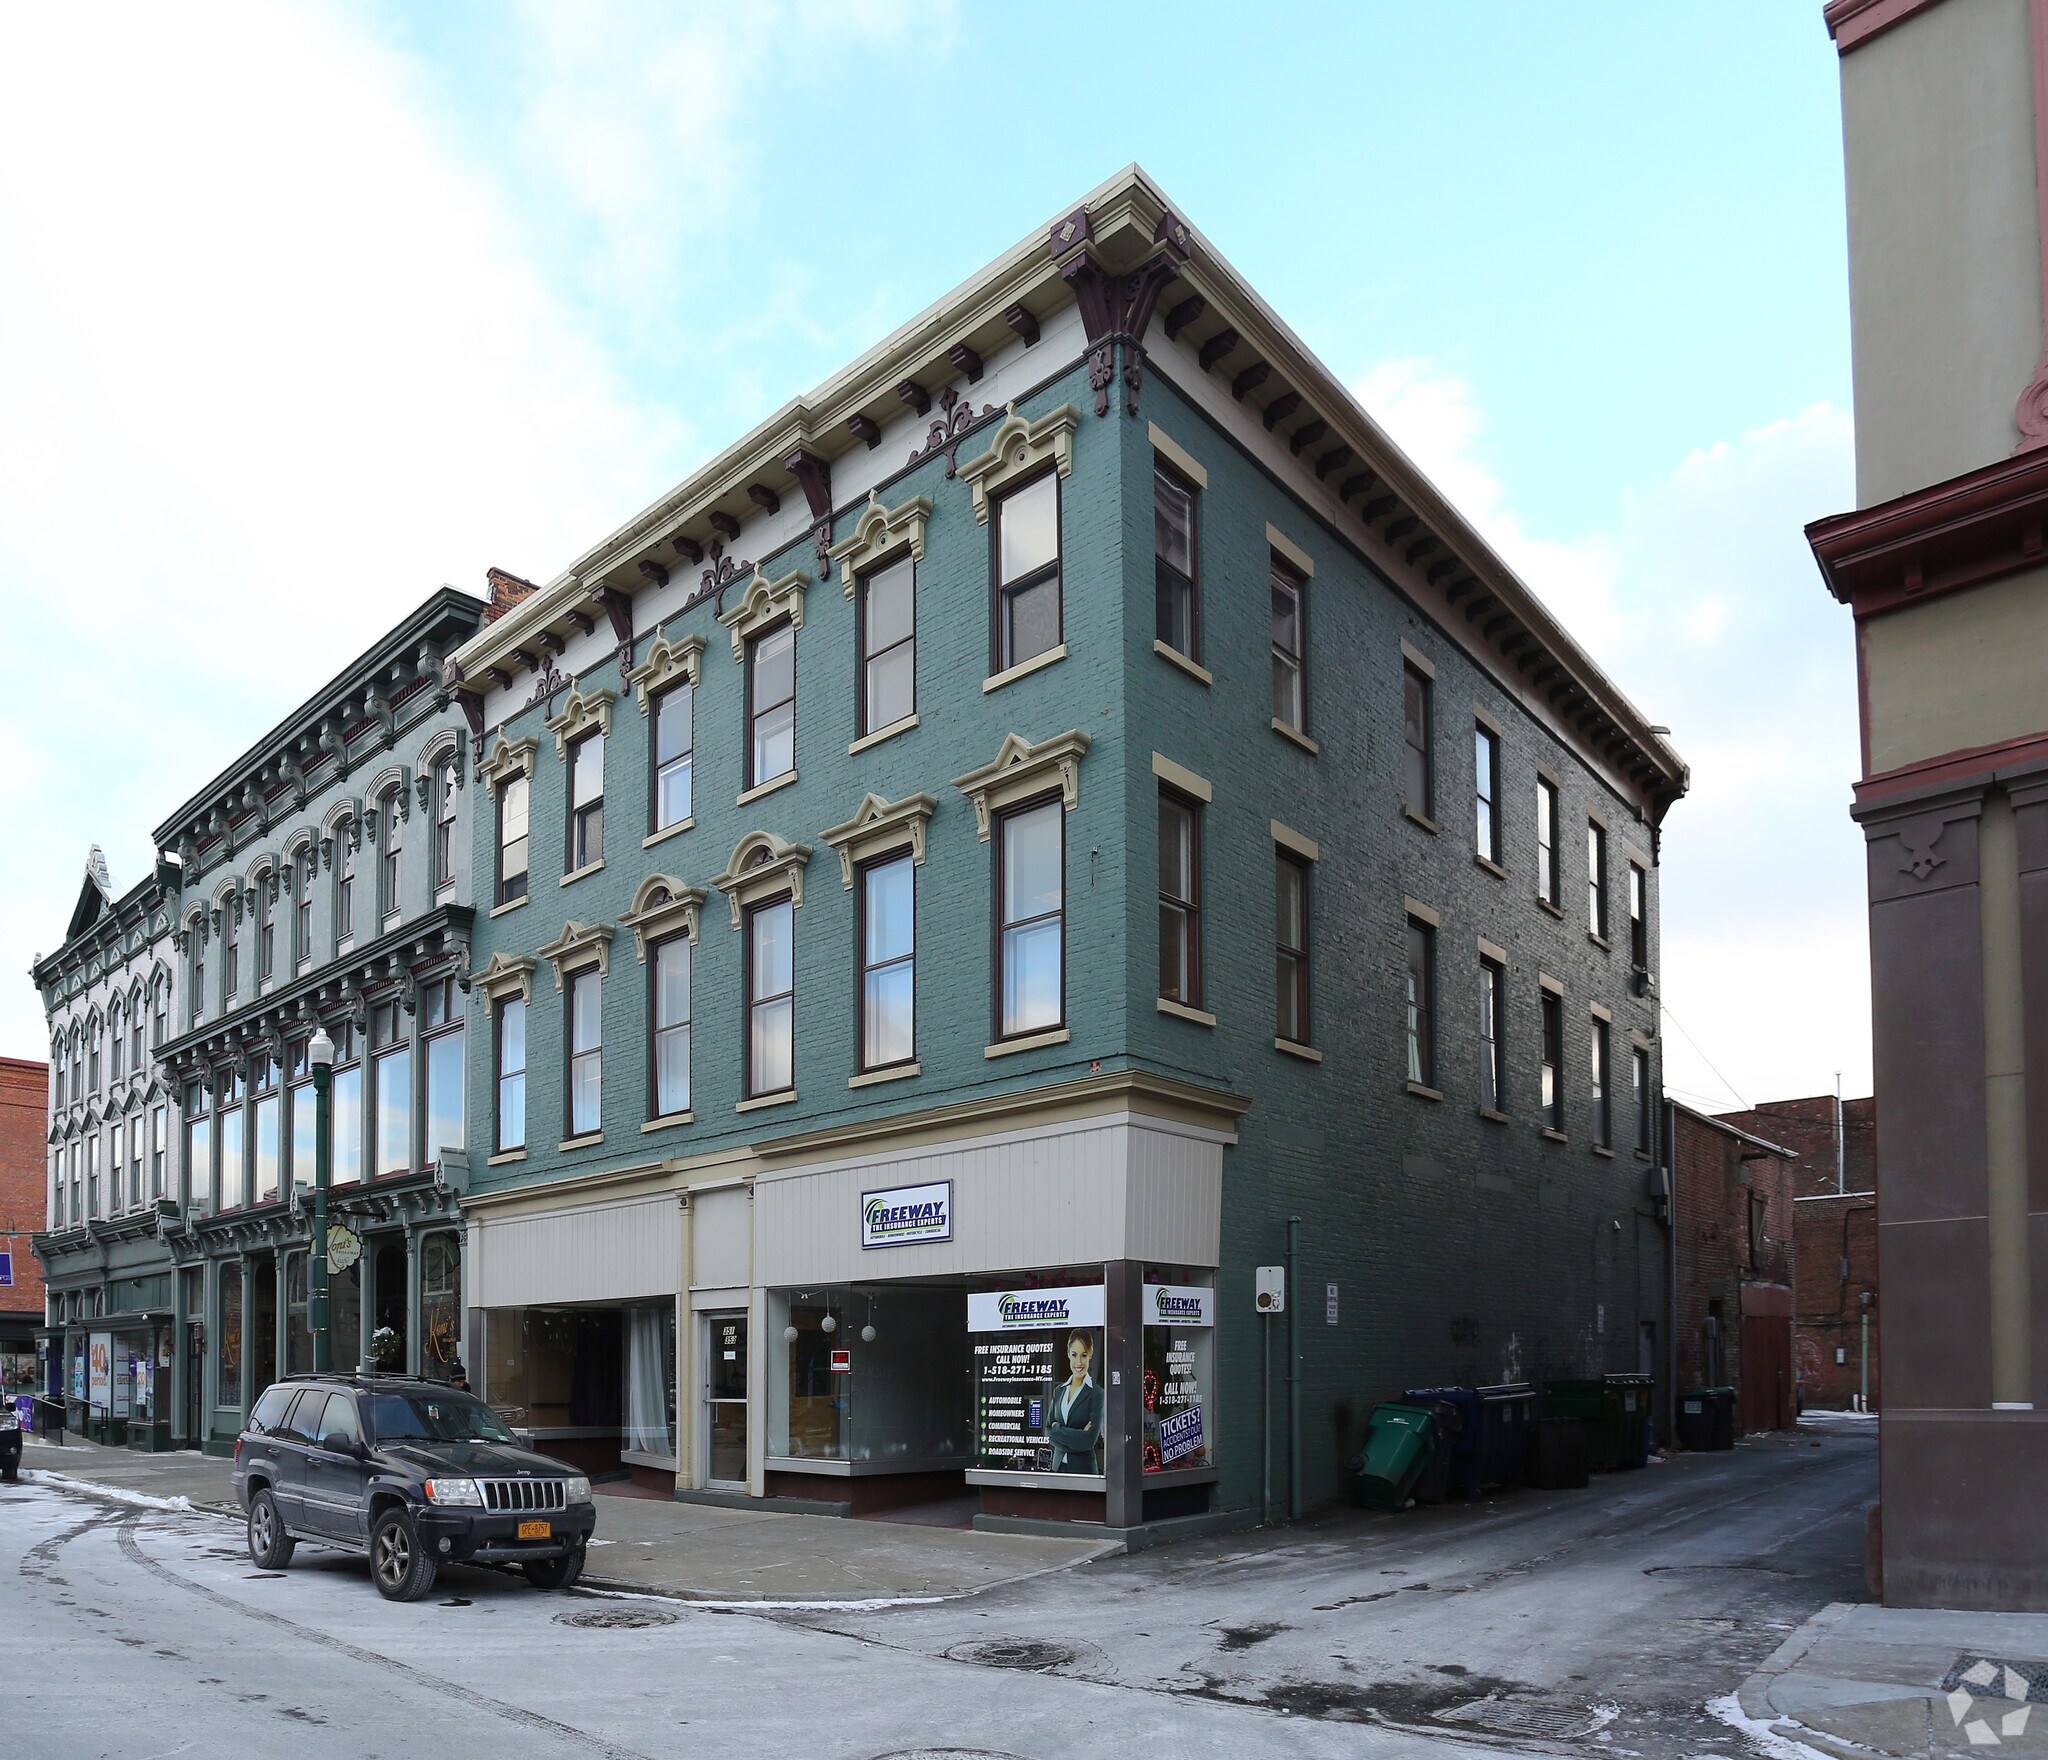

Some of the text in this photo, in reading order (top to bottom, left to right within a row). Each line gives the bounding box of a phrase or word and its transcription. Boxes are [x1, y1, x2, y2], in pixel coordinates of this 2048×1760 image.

[870, 1201, 944, 1223] FREEWAY
[872, 1217, 942, 1232] THE INSURANCE EXPERTS
[1004, 1299, 1068, 1314] FREEWAY
[1160, 1297, 1201, 1309] FREEWAY
[722, 1326, 735, 1335] 351
[724, 1335, 738, 1345] 353
[1174, 1340, 1187, 1351] FREE
[974, 1343, 1054, 1355] FREE INSURANCE QUOTES!
[996, 1354, 1030, 1364] CALL NOW!
[1165, 1352, 1196, 1363] INSURANCE
[983, 1365, 1053, 1375] 1-518-271-1185
[1169, 1363, 1192, 1376] QUOTES!
[1164, 1381, 1198, 1395] CALL NOW!
[988, 1396, 1022, 1405] AUTOMOBILE
[1159, 1394, 1203, 1405] 1-518-271-1185
[988, 1409, 1025, 1418] HOMEOWNERS
[988, 1422, 1021, 1430] COMMERCIAL
[1161, 1408, 1200, 1437] TICKETS?
[988, 1435, 1050, 1444] RECREATIONAL VEHICLES
[1163, 1428, 1191, 1448] ACCIDENTS?
[988, 1447, 1035, 1457] ROADSIDE SERVICE
[1163, 1434, 1203, 1461] NO PROBLEM
